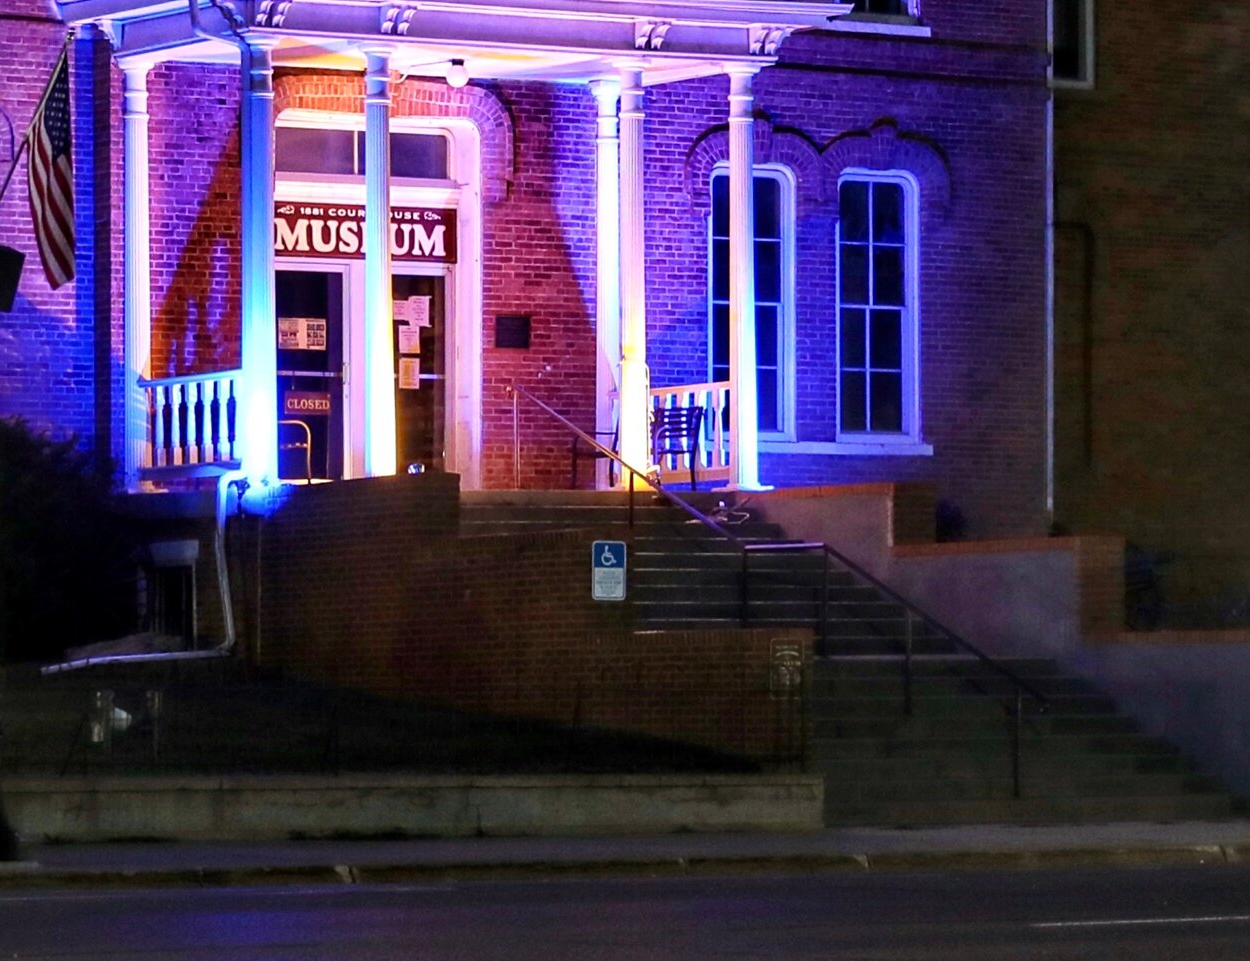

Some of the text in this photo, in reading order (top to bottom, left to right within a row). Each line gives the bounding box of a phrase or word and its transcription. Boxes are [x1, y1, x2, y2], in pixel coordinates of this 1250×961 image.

[300, 207, 421, 220] 1881 COURUSE
[274, 218, 446, 257] MUSUM
[287, 399, 330, 410] CLOSED
